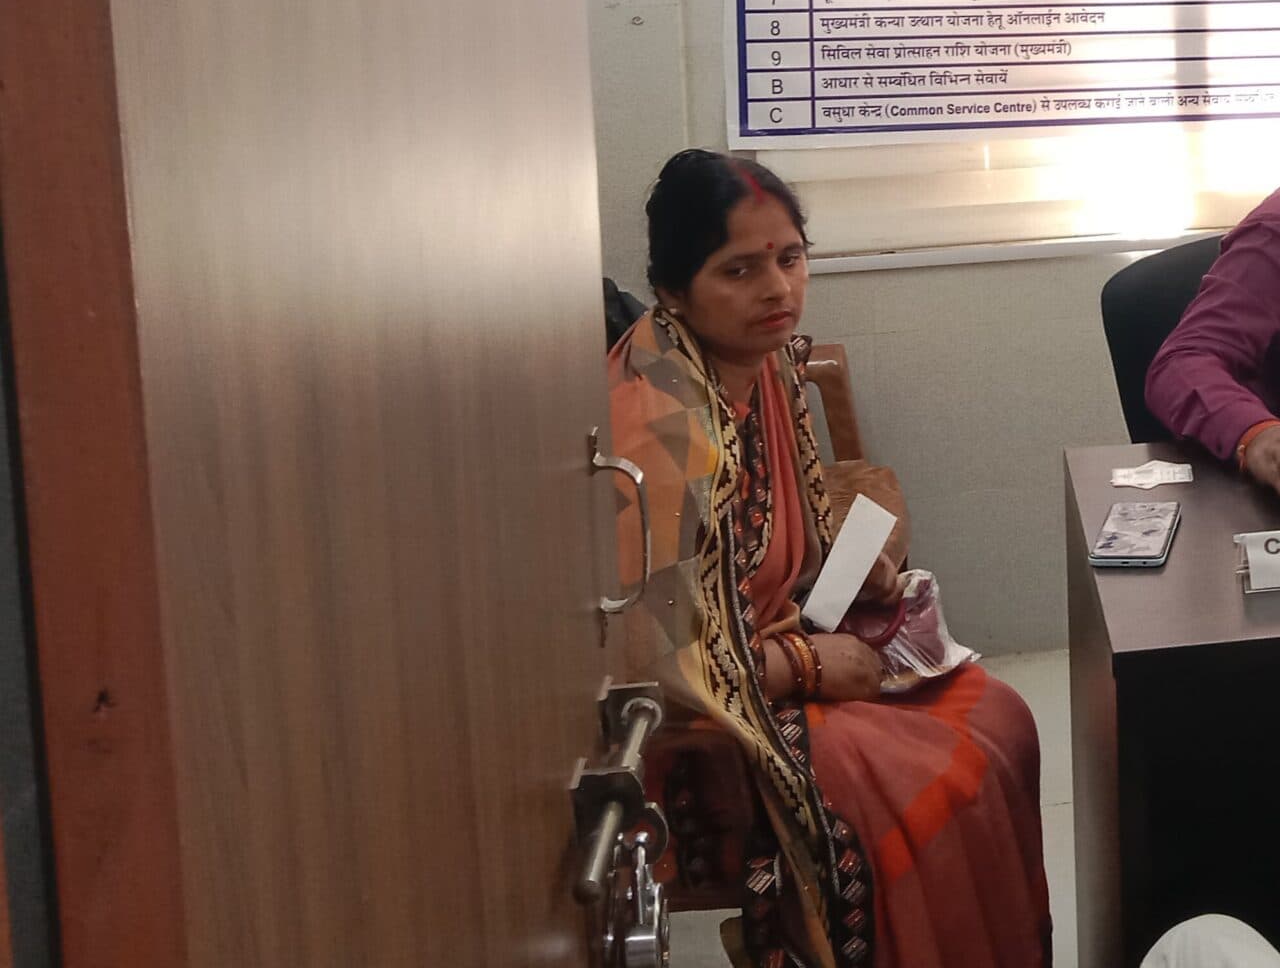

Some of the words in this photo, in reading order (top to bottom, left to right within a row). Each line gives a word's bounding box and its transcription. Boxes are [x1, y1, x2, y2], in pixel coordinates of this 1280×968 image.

[770, 20, 781, 36] 8
[820, 13, 871, 33] मुख्यमंत्री
[874, 14, 905, 28] कन्या
[947, 11, 983, 27] योजना
[1064, 8, 1105, 24] आवेदन
[770, 50, 782, 66] 9
[821, 44, 862, 61] सिविल
[866, 43, 889, 59] सेवा
[893, 43, 941, 60] प्रोत्साहन
[944, 42, 970, 57] राशि
[974, 40, 1011, 57] योजना
[771, 79, 783, 95] B
[822, 76, 859, 89] आधार
[862, 73, 877, 88] से
[929, 71, 972, 86] विभिन्न
[885, 103, 943, 117] (Common
[947, 102, 991, 116] Service
[994, 99, 1037, 114] Centre)
[1177, 94, 1200, 108] अन्य
[769, 108, 783, 123] C
